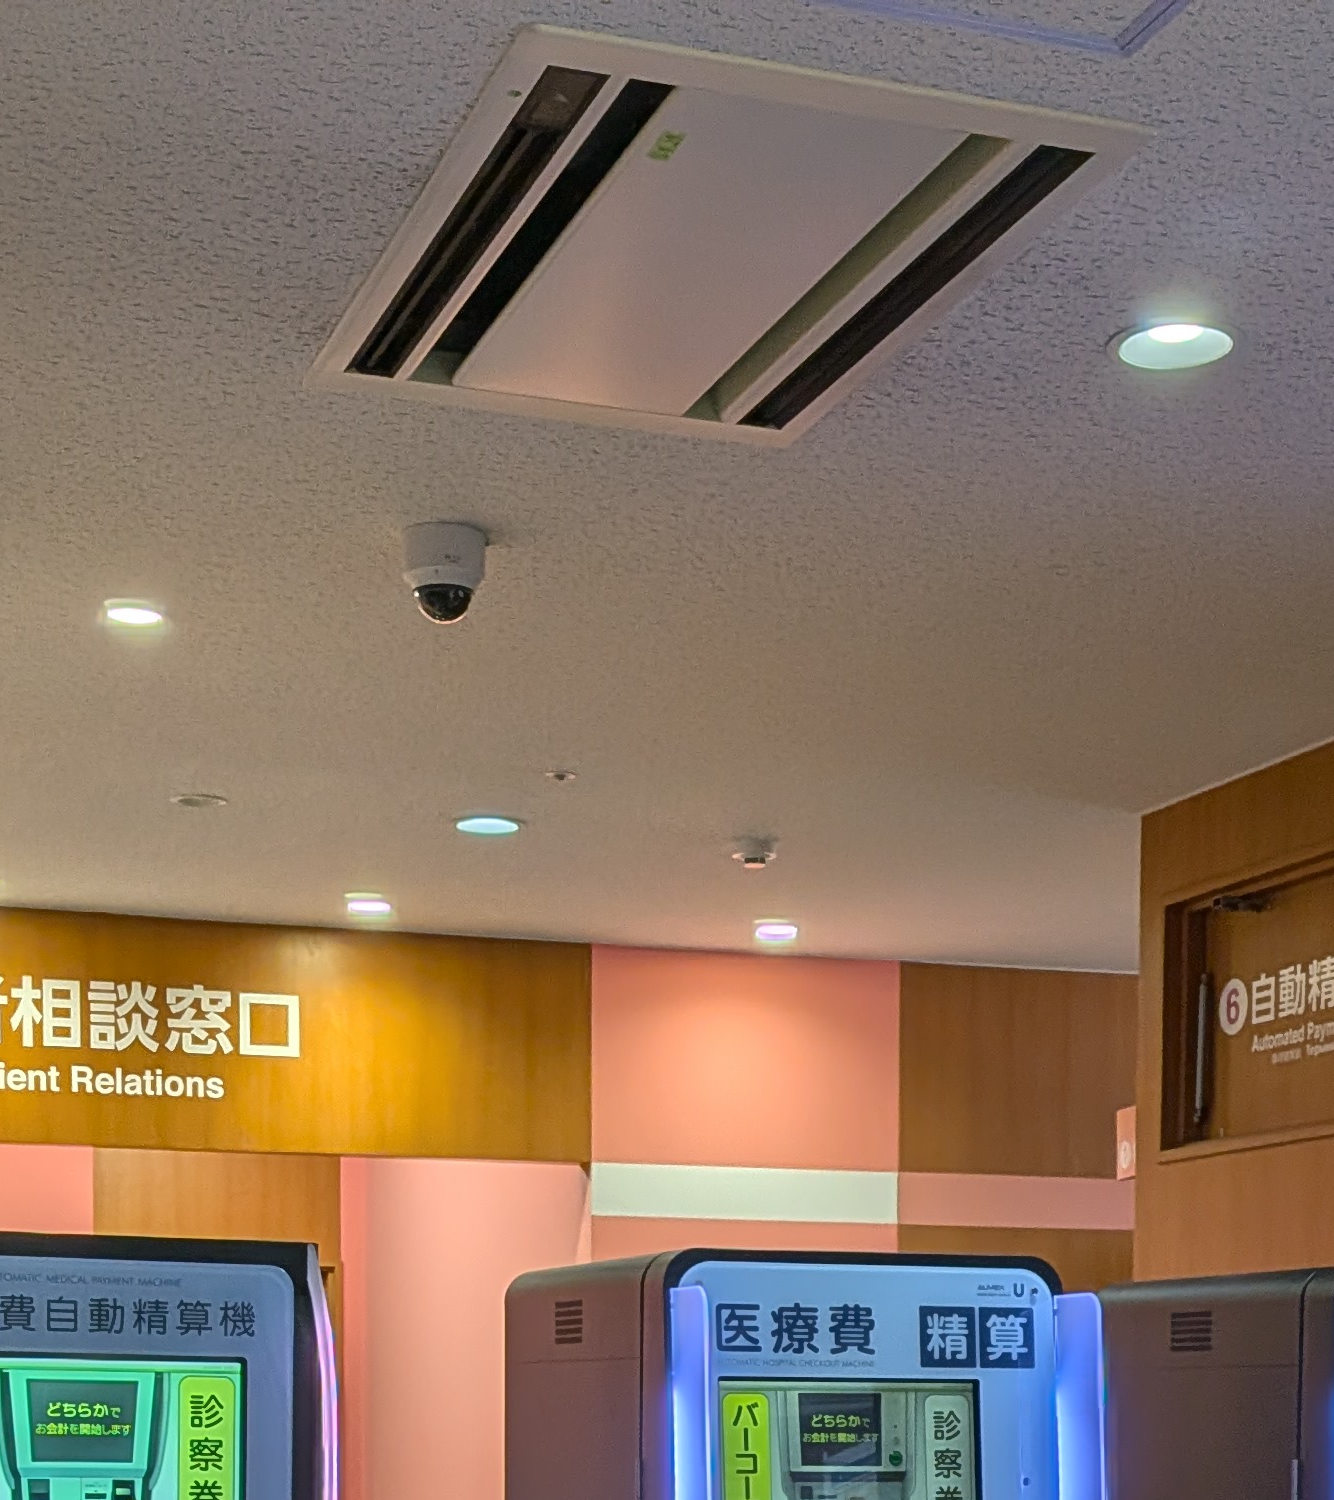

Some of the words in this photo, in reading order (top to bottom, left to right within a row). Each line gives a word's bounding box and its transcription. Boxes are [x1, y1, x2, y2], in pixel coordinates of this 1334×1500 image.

[1252, 1025, 1305, 1052] Automated
[71, 1065, 225, 1099] Relations
[715, 1302, 876, 1356] 医療費
[925, 1313, 1030, 1362] 精算
[46, 1402, 122, 1419] どちらかで
[811, 1413, 871, 1429] どちらかで
[35, 1422, 132, 1437] お会計を開始します
